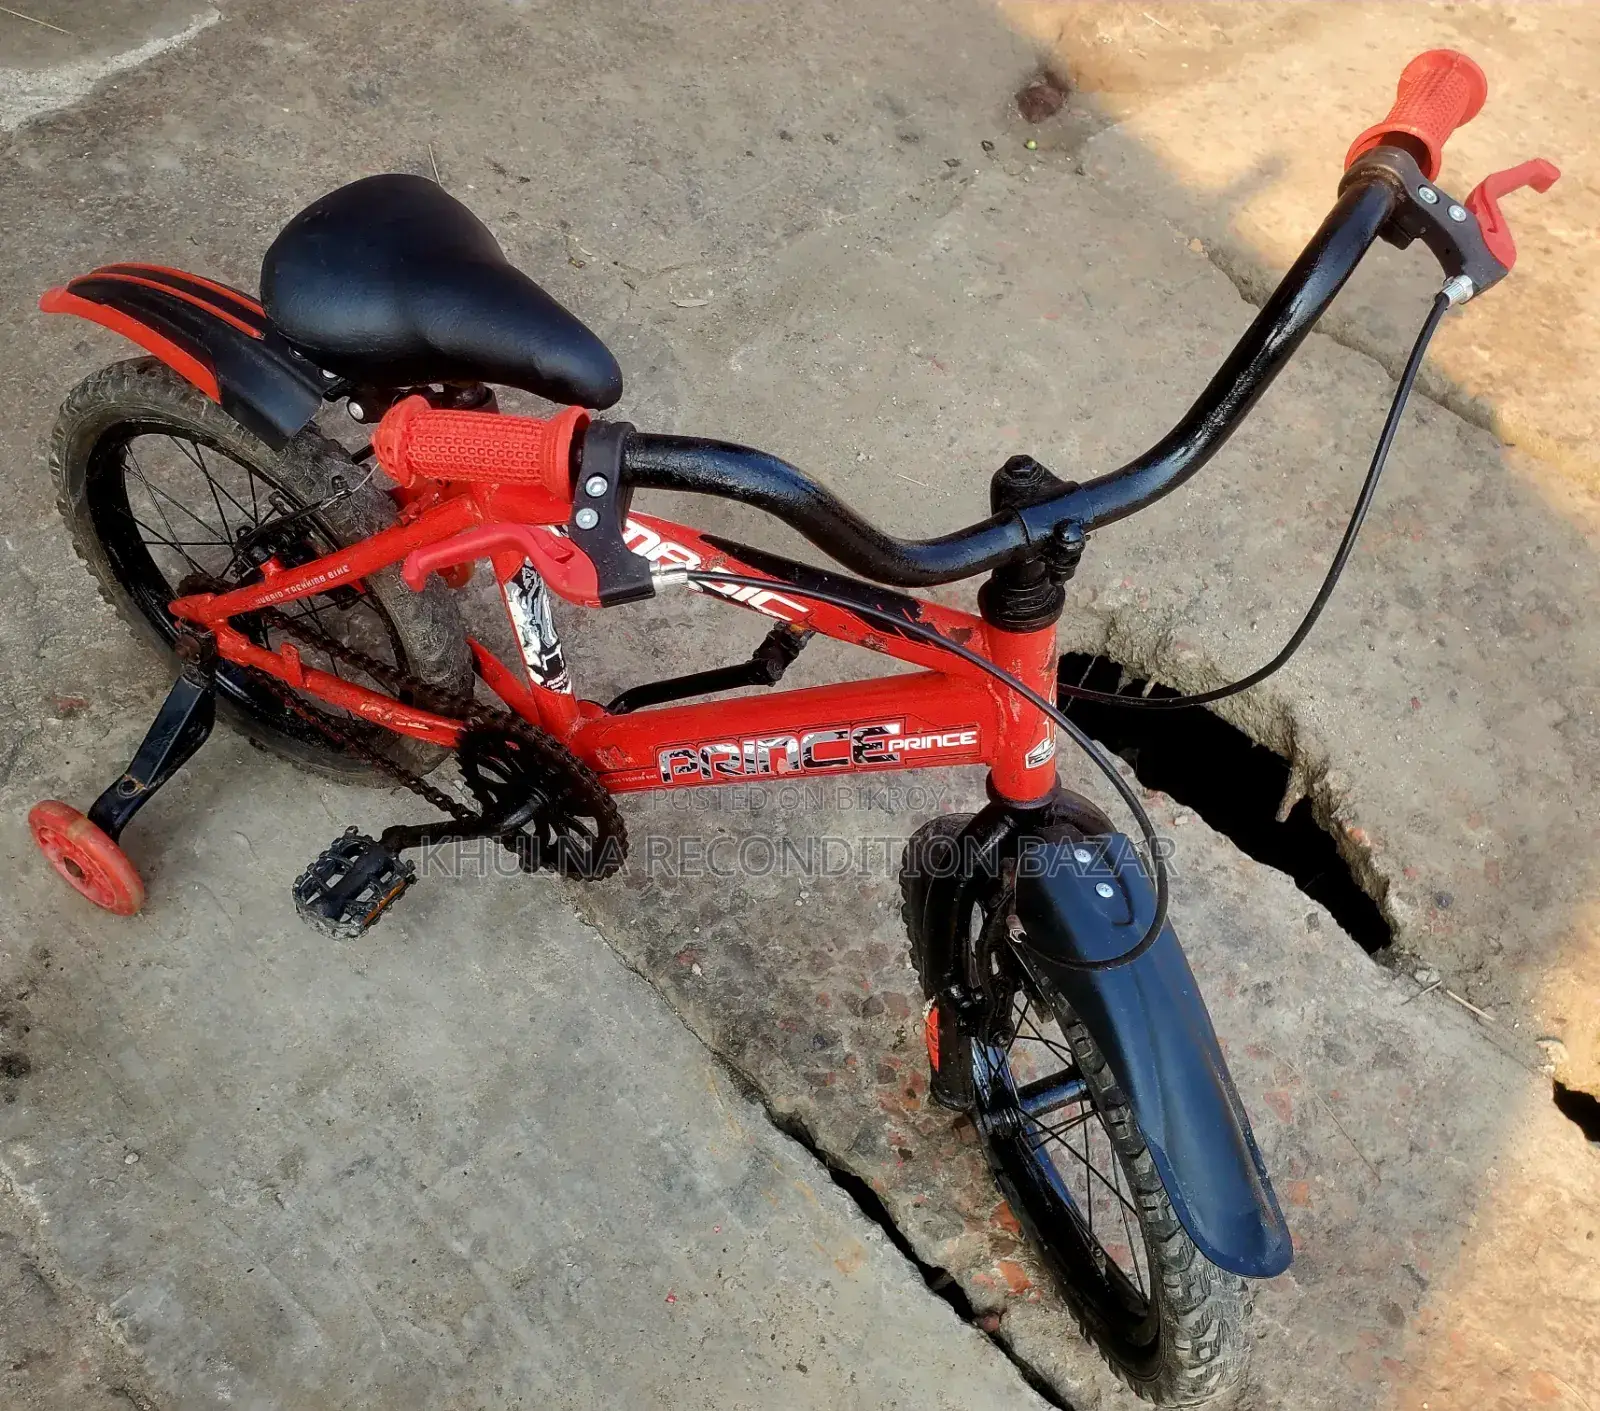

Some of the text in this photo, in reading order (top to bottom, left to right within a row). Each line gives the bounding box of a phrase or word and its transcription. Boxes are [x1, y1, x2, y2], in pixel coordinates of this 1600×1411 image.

[327, 565, 350, 579] BIKE
[658, 722, 978, 784] PRINCE PRINCE
